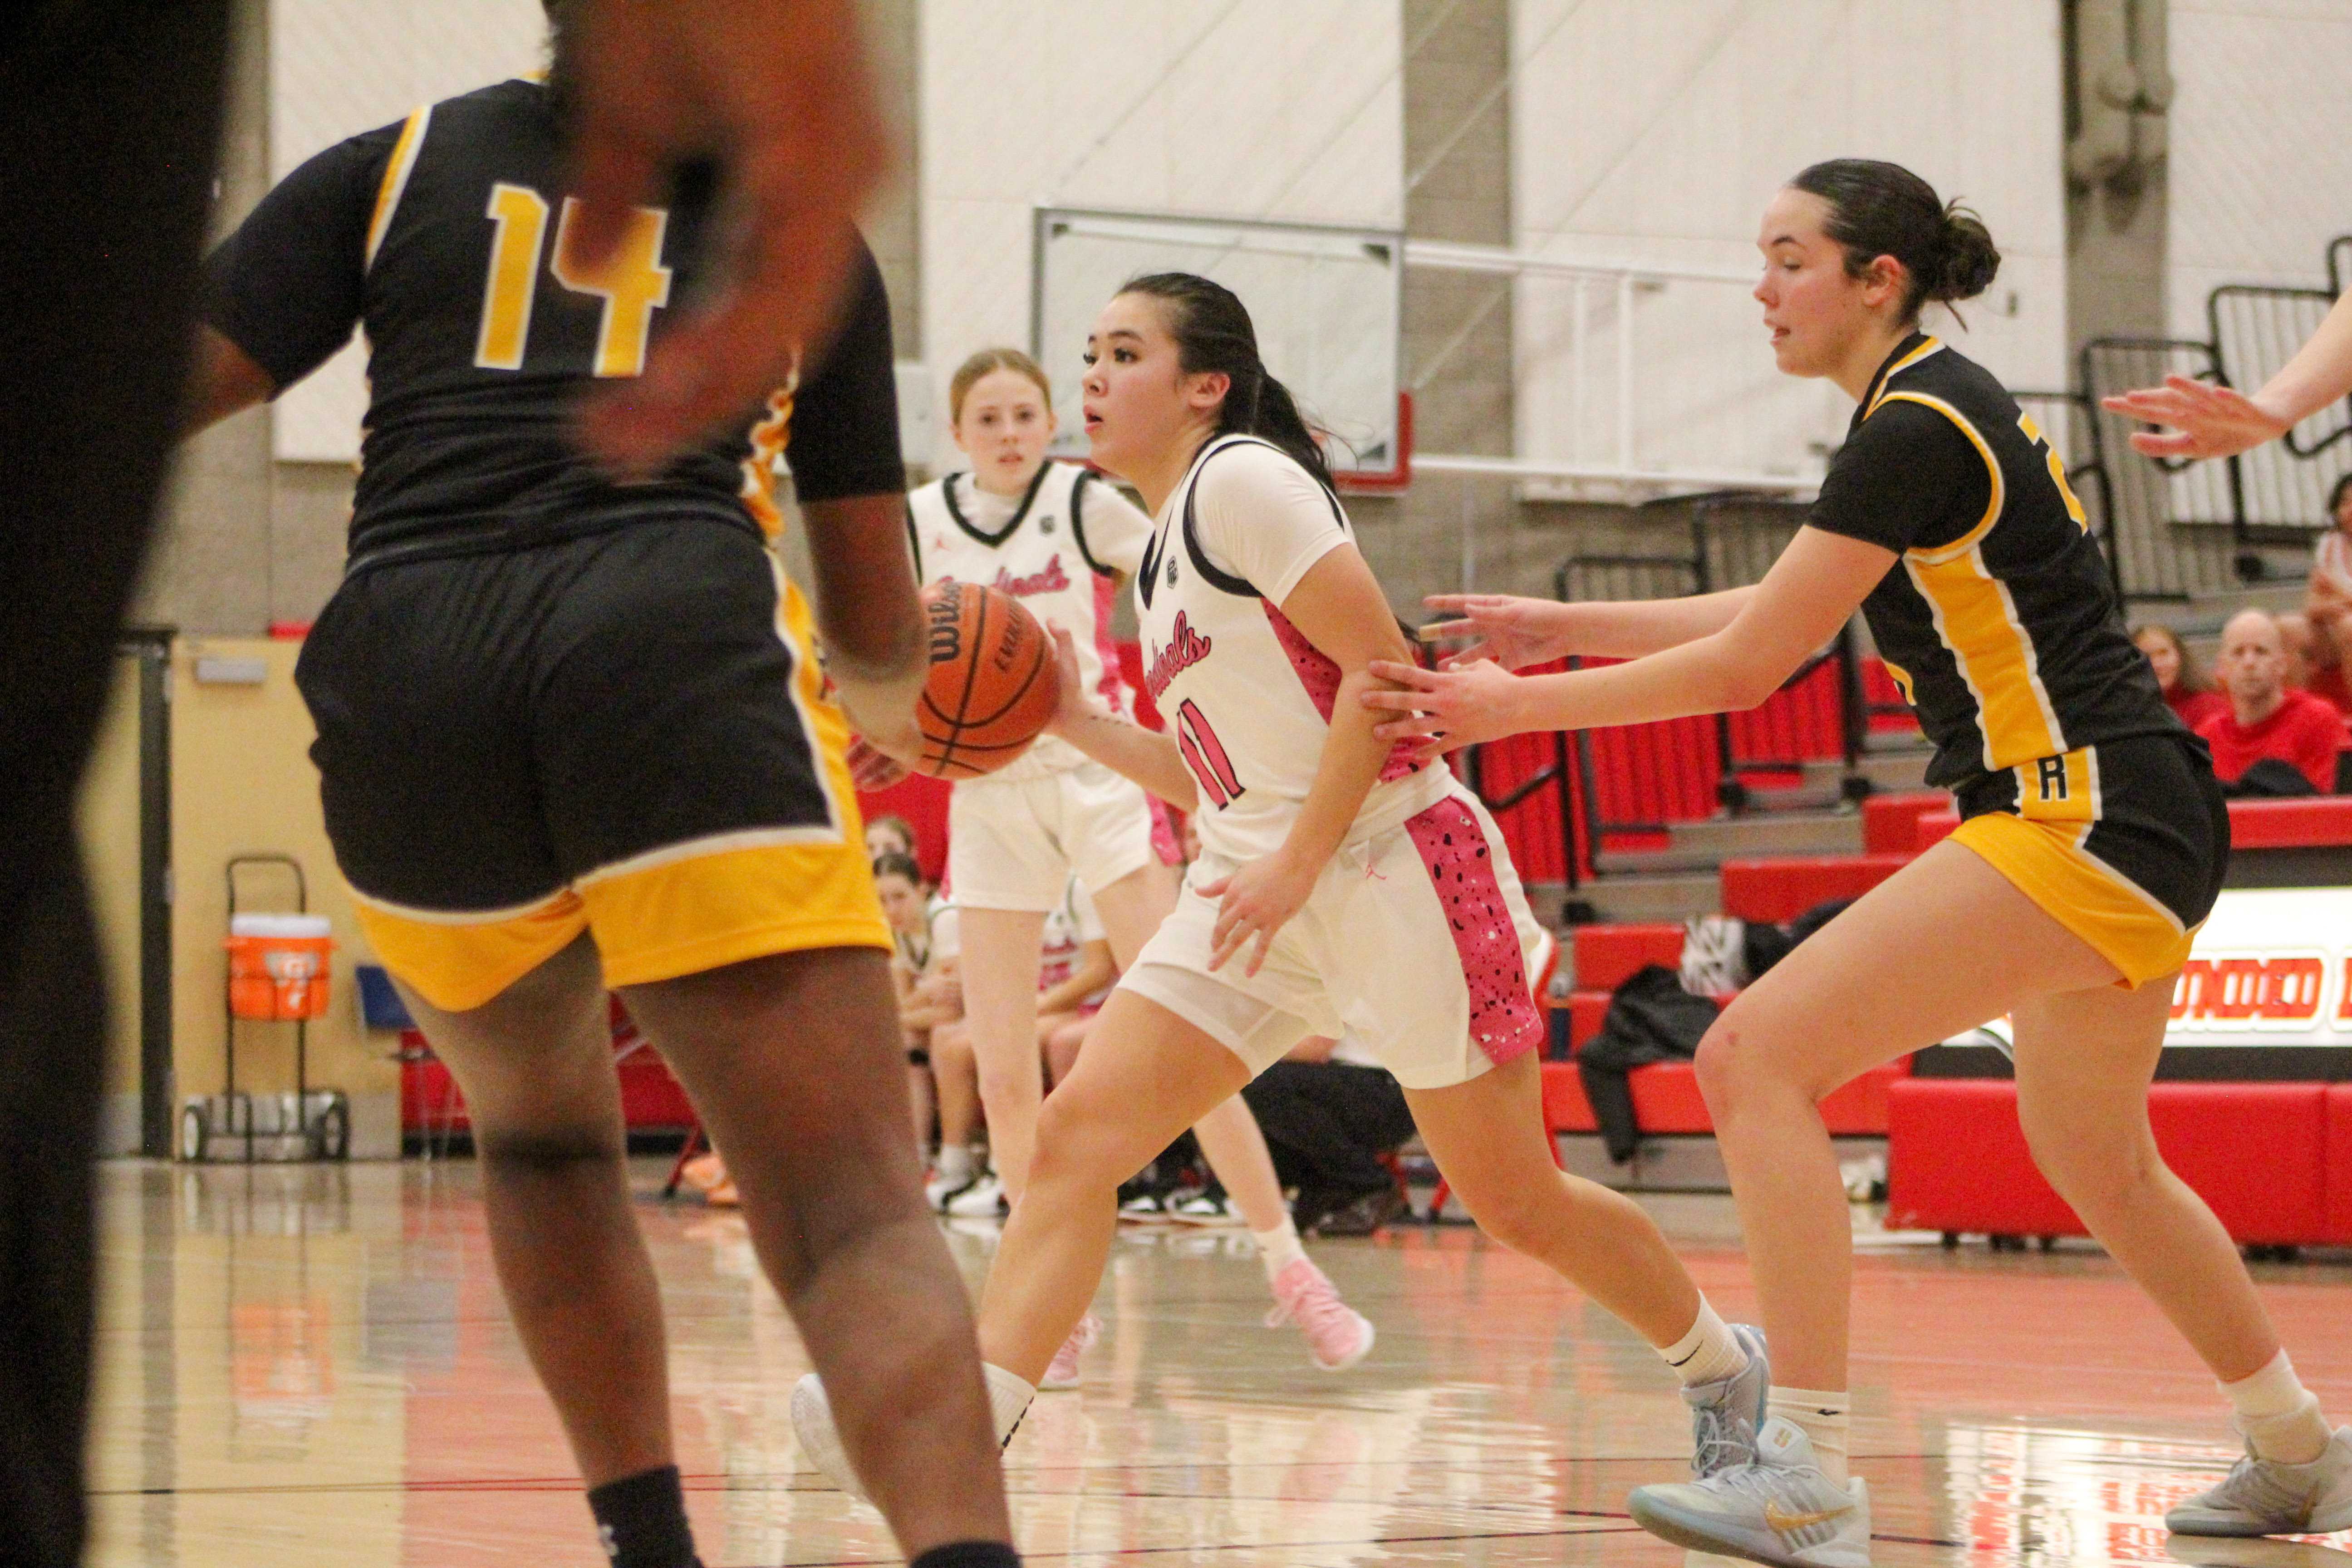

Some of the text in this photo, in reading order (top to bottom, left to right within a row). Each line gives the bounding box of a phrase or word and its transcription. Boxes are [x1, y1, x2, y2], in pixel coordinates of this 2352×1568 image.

[474, 182, 673, 378] 14
[928, 583, 960, 663] Wil
[1177, 698, 1246, 811] 11
[2037, 754, 2069, 801] R
